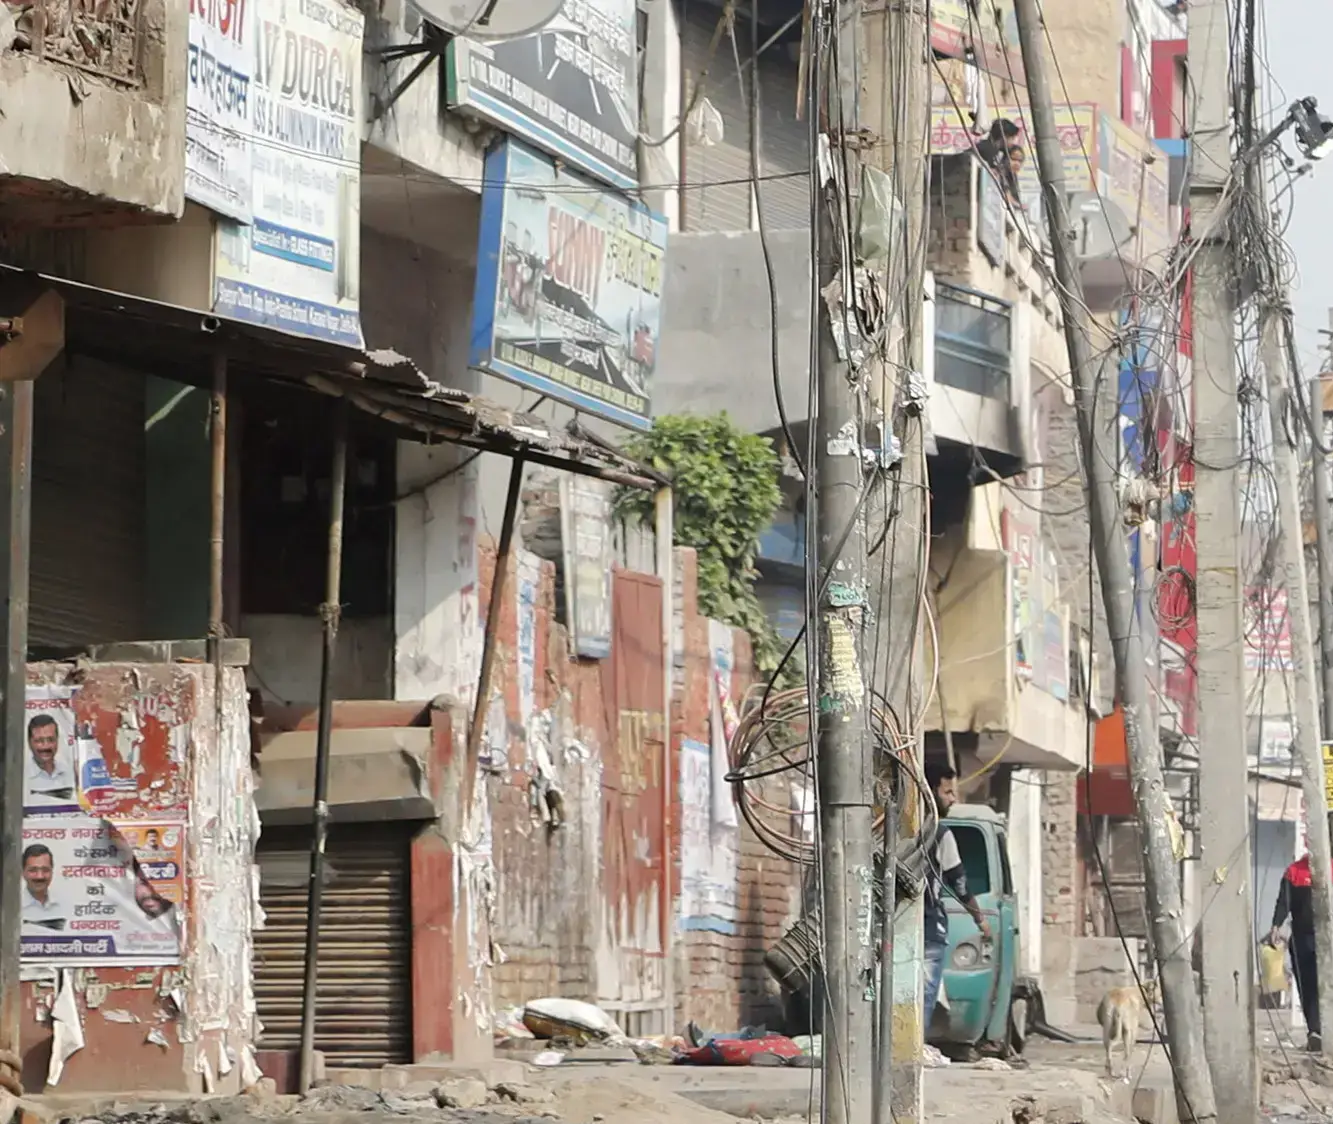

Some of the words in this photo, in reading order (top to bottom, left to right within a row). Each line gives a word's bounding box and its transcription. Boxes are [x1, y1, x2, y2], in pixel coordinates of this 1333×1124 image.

[281, 29, 355, 119] DURGA
[22, 828, 67, 840] करावल
[71, 828, 104, 839] नगर
[86, 884, 105, 896] को
[74, 901, 118, 916] हार्दिक
[70, 919, 122, 931] धन्यवाद
[83, 938, 109, 954] पार्टी
